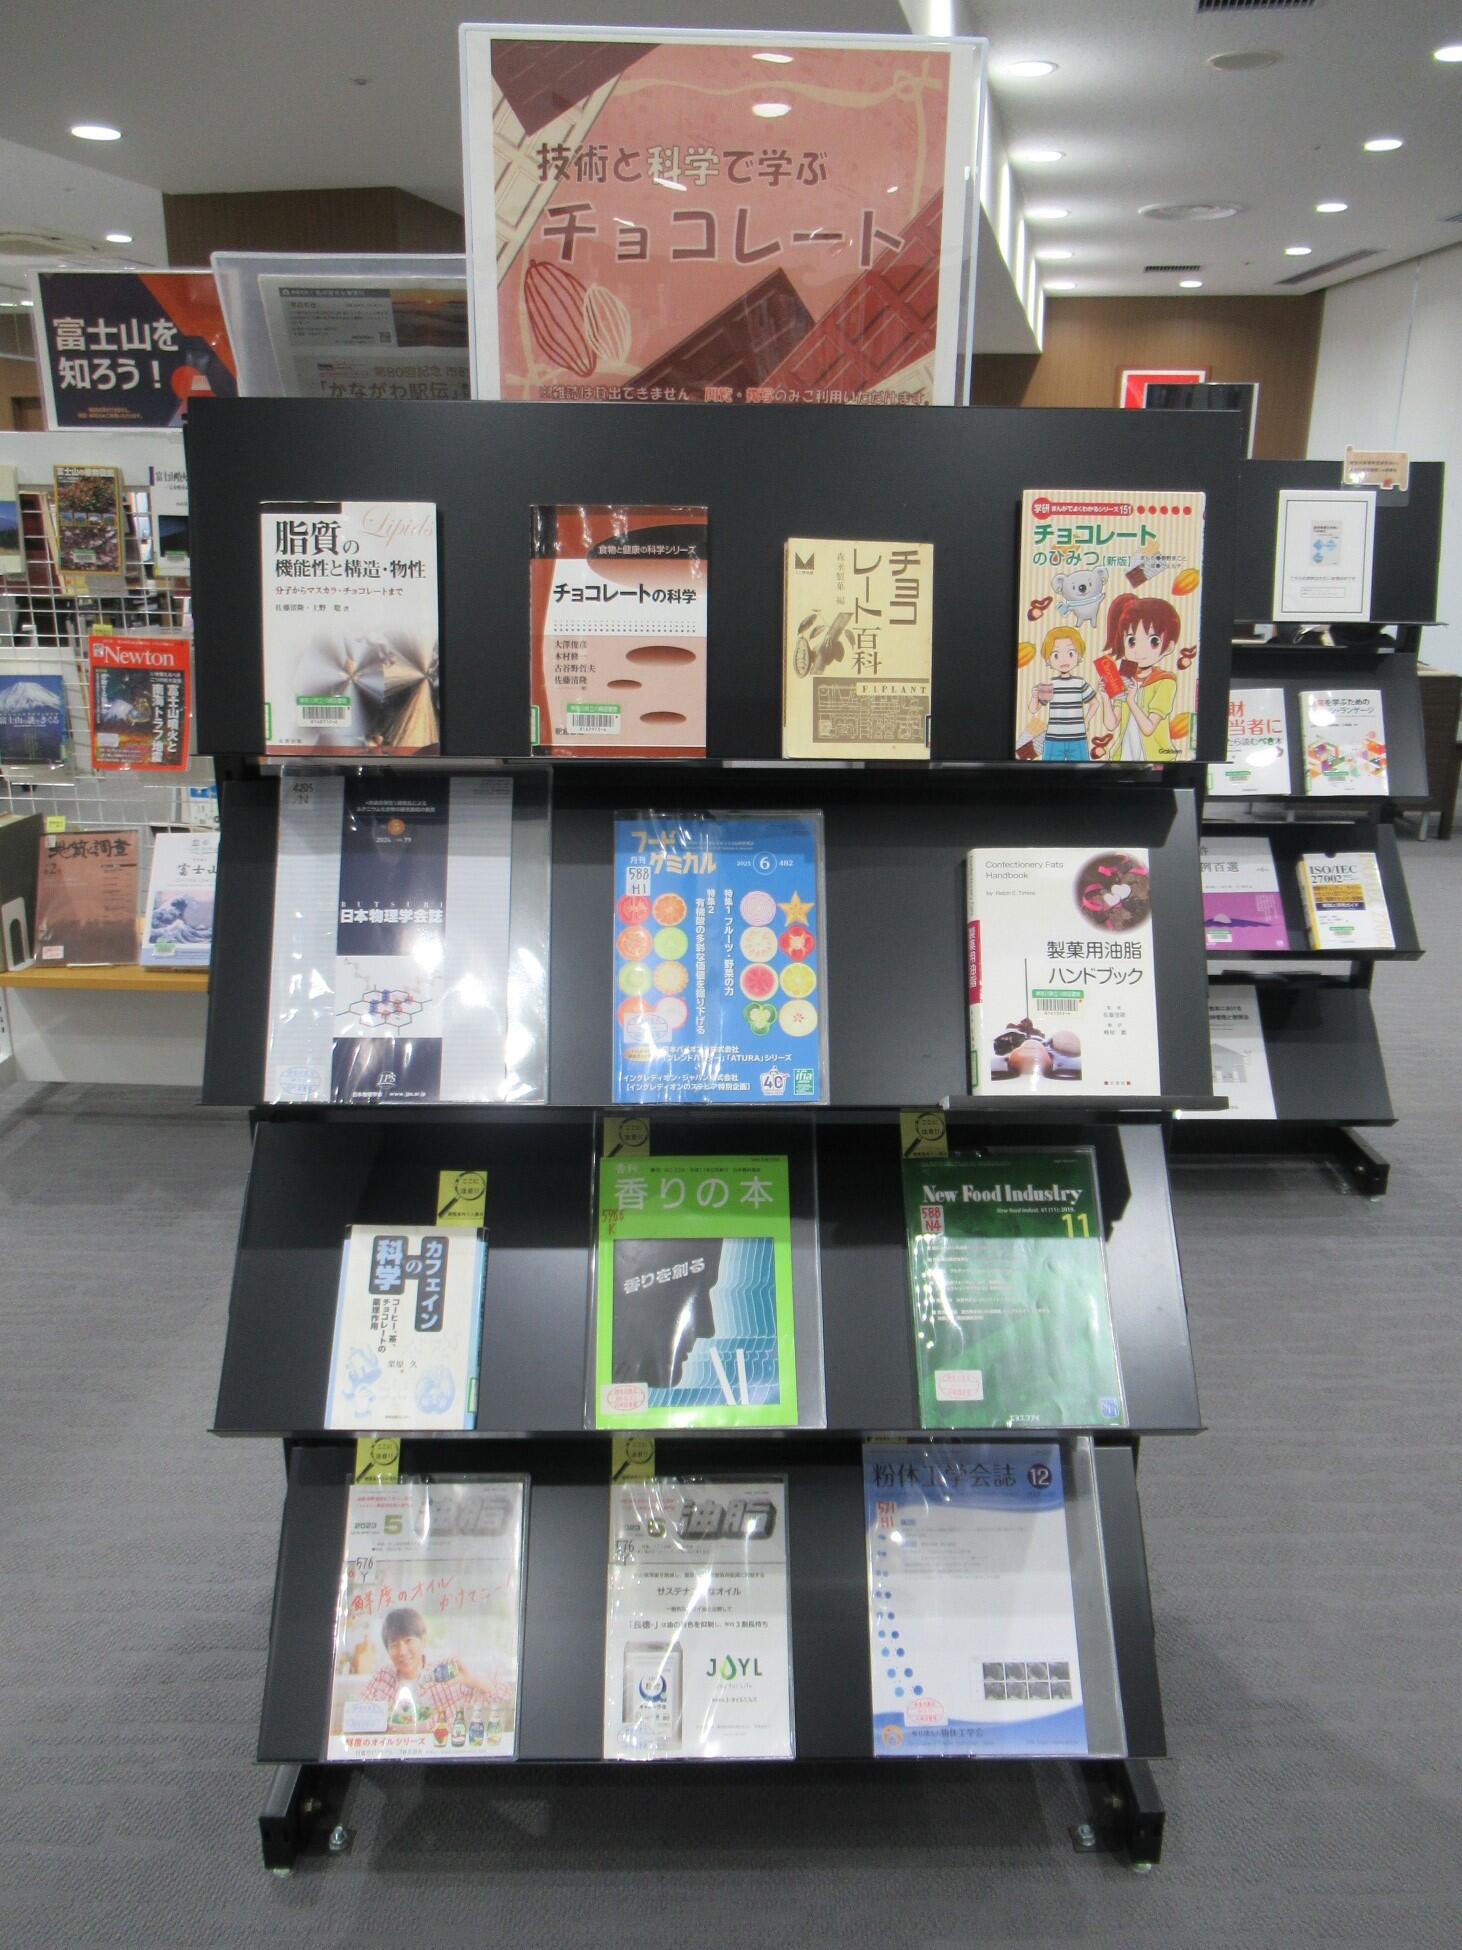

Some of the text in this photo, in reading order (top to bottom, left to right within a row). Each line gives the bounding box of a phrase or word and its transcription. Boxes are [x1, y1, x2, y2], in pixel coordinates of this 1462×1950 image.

[536, 143, 828, 187] 技術と科学で学ぶ
[543, 202, 904, 269] チョコレート
[52, 317, 179, 352] 富士山を
[59, 357, 162, 391] 知ろう！
[1034, 503, 1132, 514] 学研 まんがでよくわかるシリーズ 151
[275, 521, 360, 556] 脂質の
[1034, 524, 1157, 546] チョコレート
[599, 545, 697, 555] 食物と健康の科学シリーズ
[1033, 550, 1100, 566] のひみつ
[275, 559, 427, 579] 機能性と構造・物性
[553, 583, 697, 604] チョコレートの科学
[889, 550, 921, 625] チョコ
[851, 548, 882, 675] レート百科
[104, 646, 175, 667] Newton
[554, 664, 596, 673] 古谷野哲夫
[554, 676, 588, 685] 佐藤清隆
[1228, 719, 1283, 736] 当者に
[631, 831, 676, 853] フード
[630, 857, 646, 865] 月刊
[758, 856, 771, 870] 6
[985, 861, 1064, 870] Confectionery Fats
[1309, 864, 1358, 875] ISO/IEC
[629, 867, 650, 880] 588
[985, 871, 1028, 879] Handbook
[1311, 874, 1344, 884] 27002
[706, 888, 716, 914] 特集2
[340, 909, 444, 924] 日本物理学会誌
[724, 889, 735, 997] 特集1 フルーツ・野菜の力
[1047, 940, 1142, 960] 製菓用油脂
[1049, 967, 1143, 985] ハンドブック
[615, 1175, 773, 1210] 香りの本
[922, 1184, 1083, 1205] New Food Industry
[921, 1207, 941, 1219] 588
[608, 1223, 616, 1235] K
[925, 1219, 942, 1232] N4
[1062, 1213, 1090, 1239] 11
[374, 1239, 443, 1330] カフェイン の 科学
[623, 1257, 706, 1296] 香りを創る
[378, 1299, 390, 1353] チョコレートの
[873, 1463, 1050, 1488] 粉体工学会誌 12
[384, 1514, 403, 1535] 5
[356, 1557, 374, 1569] 576
